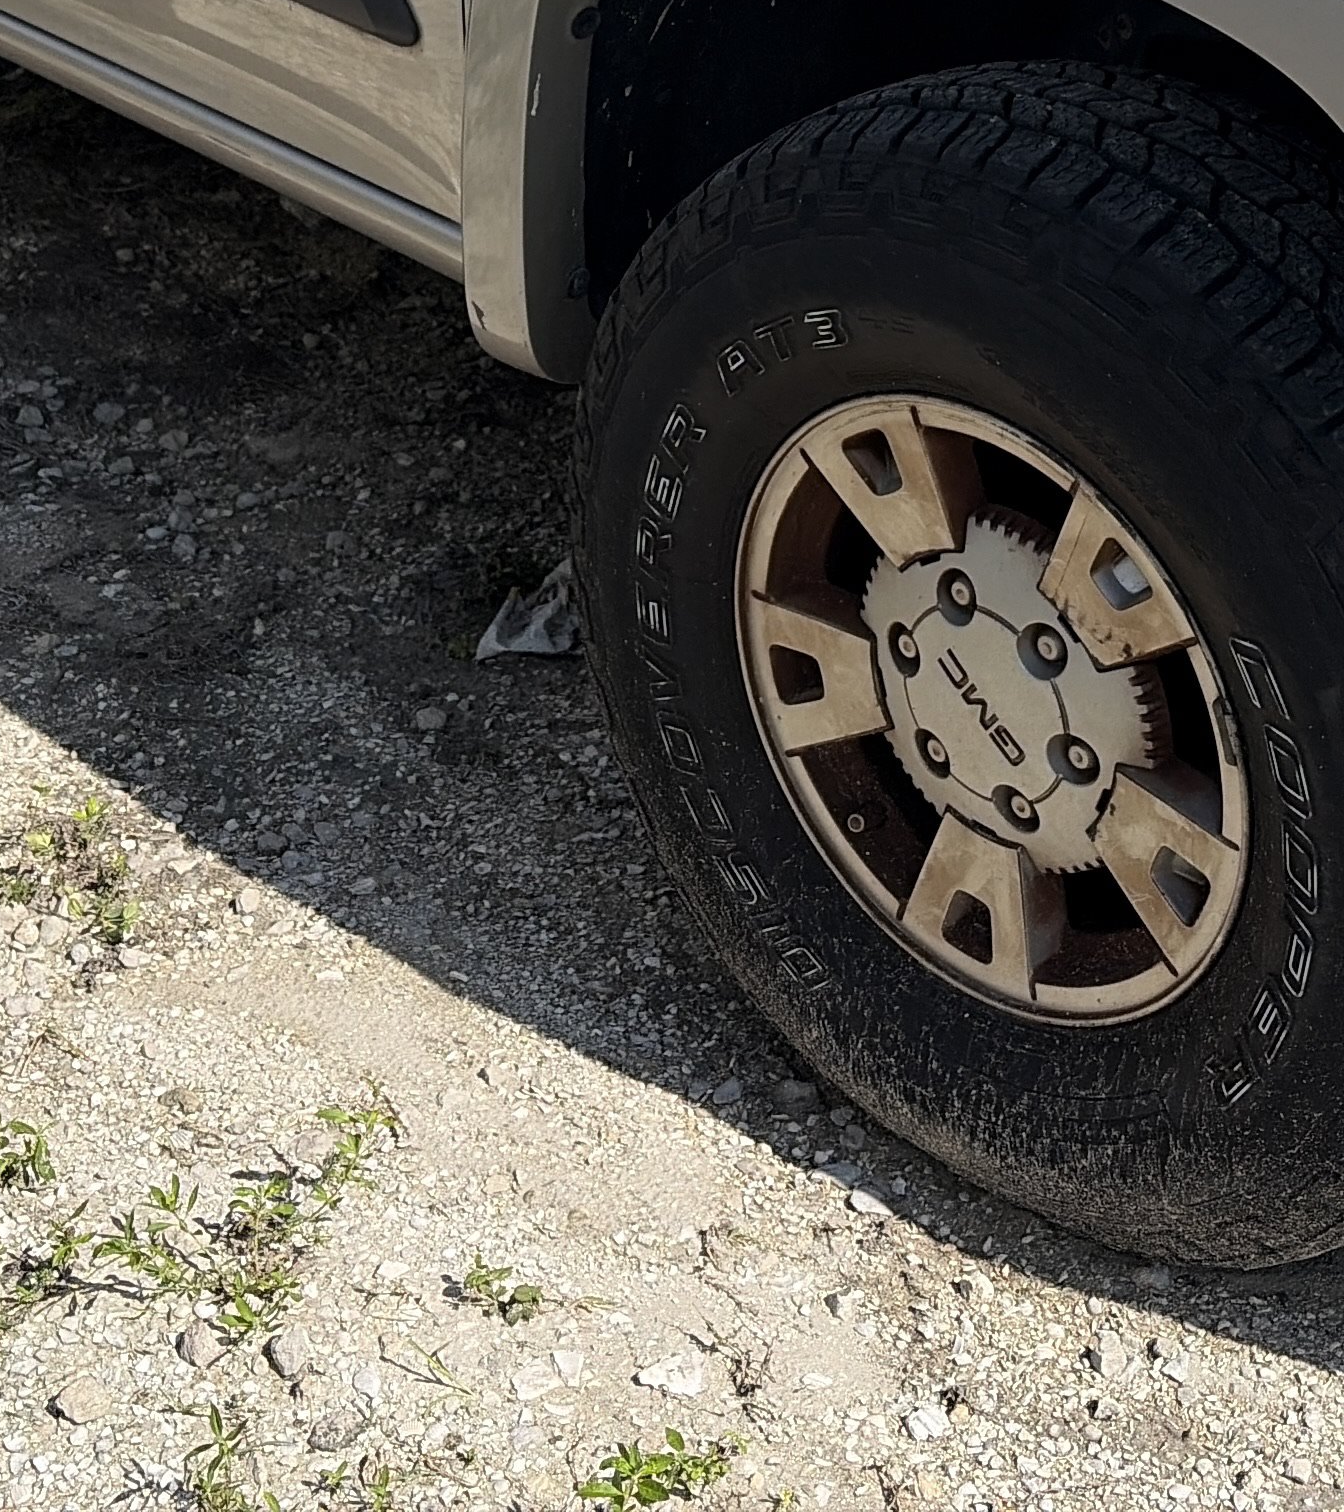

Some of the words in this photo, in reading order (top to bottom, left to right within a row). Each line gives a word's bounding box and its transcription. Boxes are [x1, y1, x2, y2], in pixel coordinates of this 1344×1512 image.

[716, 308, 849, 398] AT3
[635, 403, 832, 991] DISCOVERER
[937, 647, 1027, 767] GMC
[1204, 636, 1319, 1110] COOPER
